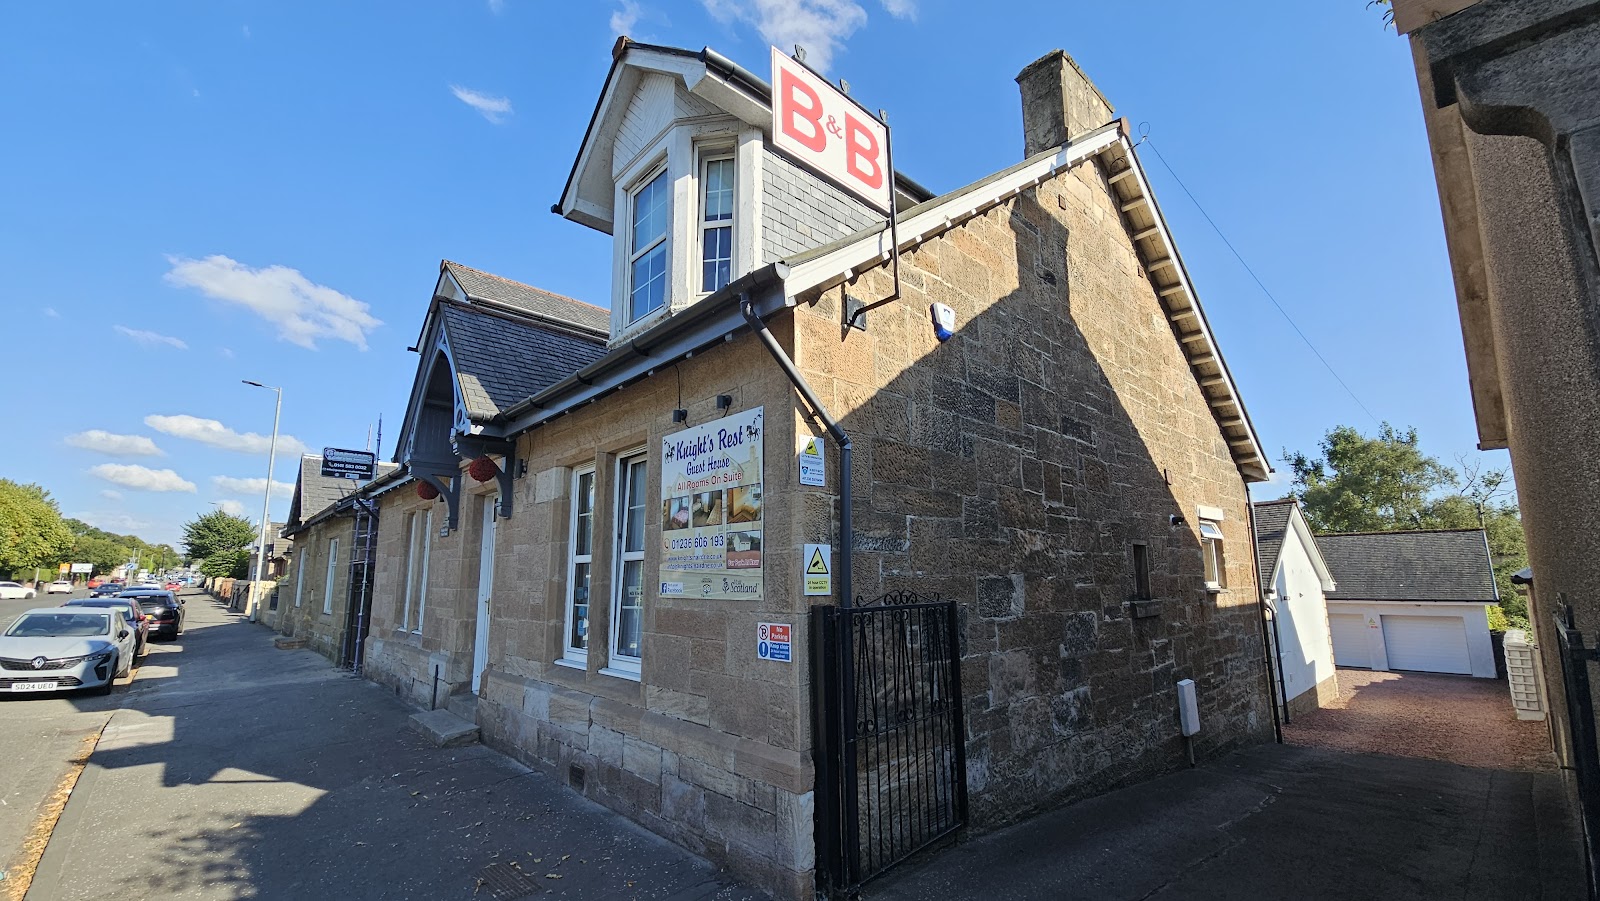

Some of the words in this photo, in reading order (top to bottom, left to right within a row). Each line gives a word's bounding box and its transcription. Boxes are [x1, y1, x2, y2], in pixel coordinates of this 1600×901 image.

[781, 66, 882, 189] B&B
[676, 434, 714, 461] Knight's
[718, 426, 744, 450] Rest
[687, 461, 705, 475] Guest
[708, 456, 730, 472] House
[677, 483, 686, 491] All
[687, 479, 710, 490] Rooms
[711, 475, 721, 485] On
[723, 471, 743, 483] Suite
[671, 538, 692, 550] 01236
[694, 536, 708, 548] 606
[710, 535, 724, 546] 193
[730, 582, 758, 593] Scotland
[771, 633, 788, 641] Parking
